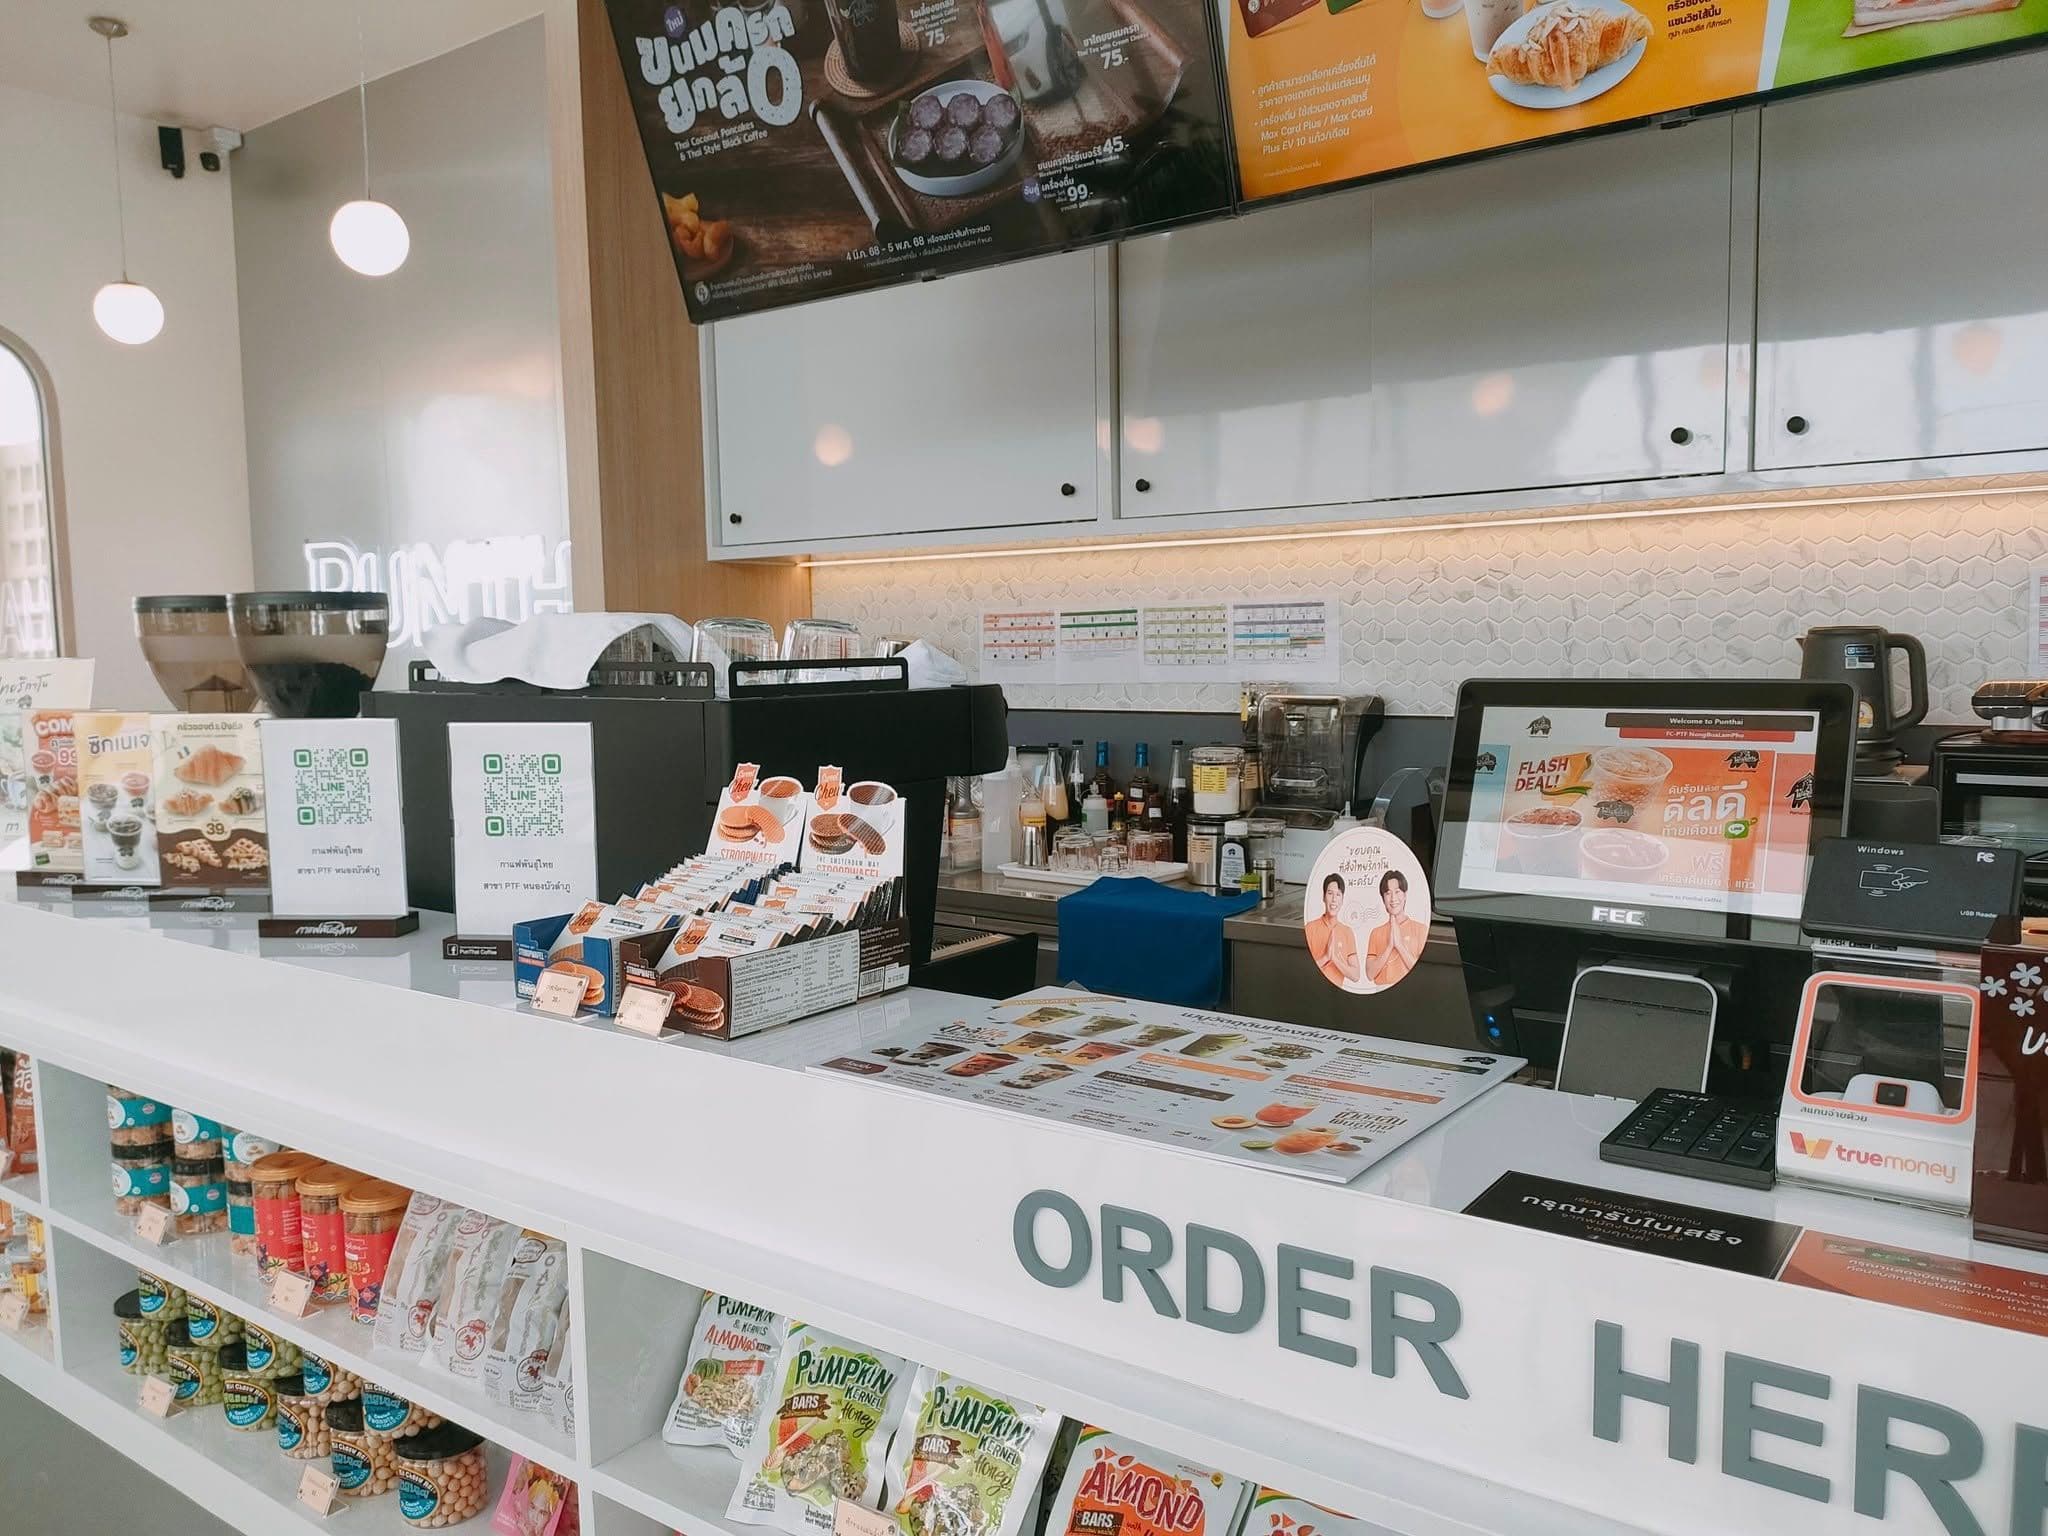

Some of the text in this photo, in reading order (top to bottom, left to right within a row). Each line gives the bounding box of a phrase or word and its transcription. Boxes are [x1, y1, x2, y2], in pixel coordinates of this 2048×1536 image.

[666, 10, 684, 32] ใหม่
[1100, 48, 1129, 70] 75.-
[1261, 129, 1278, 141] Max
[1280, 123, 1301, 136] Card
[1303, 120, 1321, 131] Plus
[1330, 112, 1349, 124] Max
[1351, 106, 1373, 119] Card
[674, 121, 754, 151] Thai Coconut Pancakes
[686, 147, 702, 159] Thai
[703, 142, 721, 155] Style
[721, 136, 742, 149] Black
[743, 130, 768, 143] Coffee
[1103, 135, 1129, 155] 45.-
[1262, 143, 1280, 155] Plus
[1282, 140, 1294, 150] EV
[1296, 136, 1306, 147] 10
[846, 252, 852, 261] 4
[869, 246, 880, 257] 68
[887, 242, 893, 253] 5
[912, 236, 925, 247] 68
[1670, 717, 1744, 726] Welcome to Punthai
[1518, 757, 1568, 776] FLASH
[321, 783, 345, 792] LINE
[1515, 774, 1560, 792] DEAL!
[510, 790, 537, 801] LINE
[1664, 780, 1748, 823] ดีลดี
[312, 846, 363, 857] กาแฟพันธุ์ไทย
[1691, 848, 1726, 873] ฟรี
[1857, 845, 1905, 856] Windows
[317, 867, 331, 875] PTF
[500, 859, 553, 871] กาแฟพันธุ์ไทย
[484, 880, 570, 893] สาขา PTF หนองบัวลำภู
[1591, 905, 1648, 927] FEC
[1800, 1106, 1868, 1123] สแกนจ่ายด้วย
[1836, 1143, 1958, 1184] truemoney
[1521, 1195, 1743, 1246] กรุณารับใบเสร็จ
[1013, 1188, 1470, 1401] ORDER
[718, 1295, 776, 1323] PUMPKIN
[796, 1350, 894, 1394] PUMPKIN
[792, 1395, 819, 1410] BARS
[845, 1385, 881, 1409] KERNEL
[841, 1402, 877, 1438] Honey
[927, 1386, 1032, 1448] PUMPKIN
[922, 1438, 949, 1454] BARS
[979, 1434, 1018, 1466] KERNEL
[974, 1455, 1012, 1497] Honey
[1080, 1461, 1204, 1530] ALMOND
[1082, 1512, 1113, 1527] BARS
